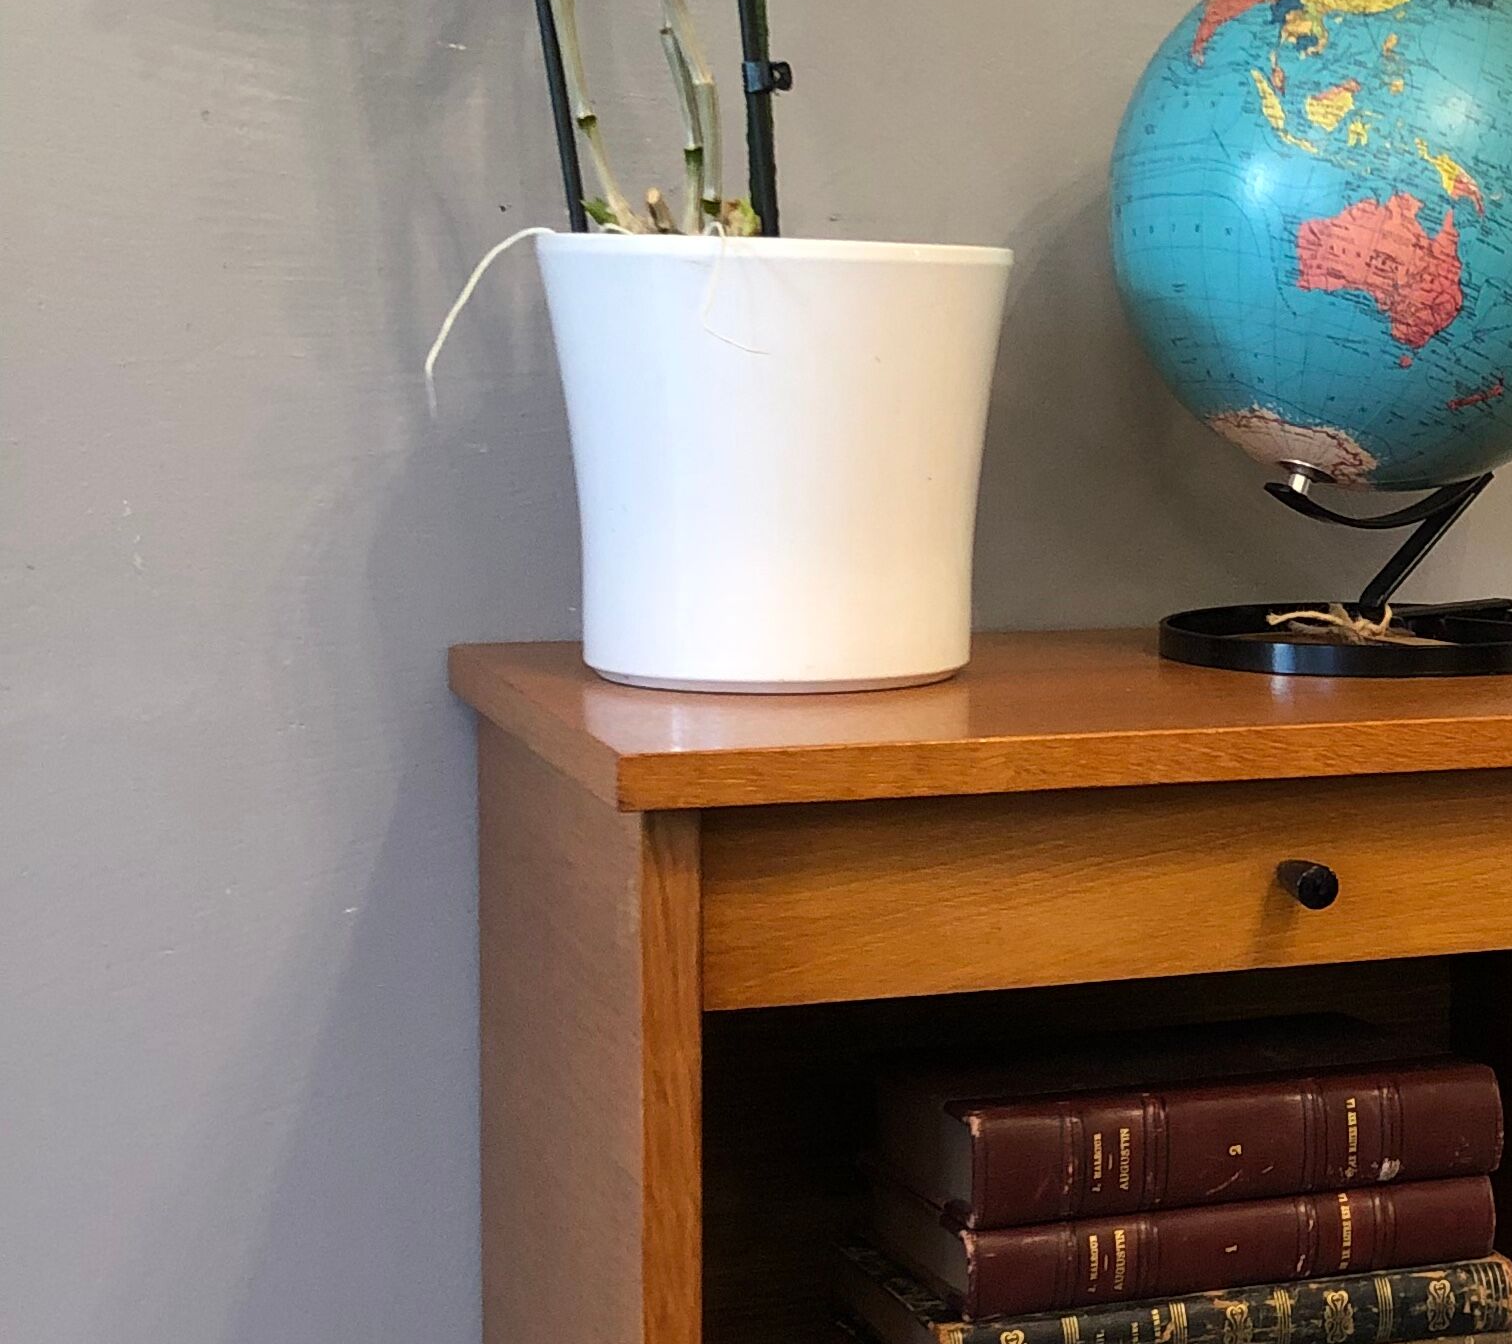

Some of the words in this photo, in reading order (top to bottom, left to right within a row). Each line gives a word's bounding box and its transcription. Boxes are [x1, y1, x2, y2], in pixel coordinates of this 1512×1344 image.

[1119, 1127, 1131, 1190] AUGUSTIN
[1228, 1144, 1242, 1156] 2
[1113, 1229, 1126, 1291] AUGUSTIN
